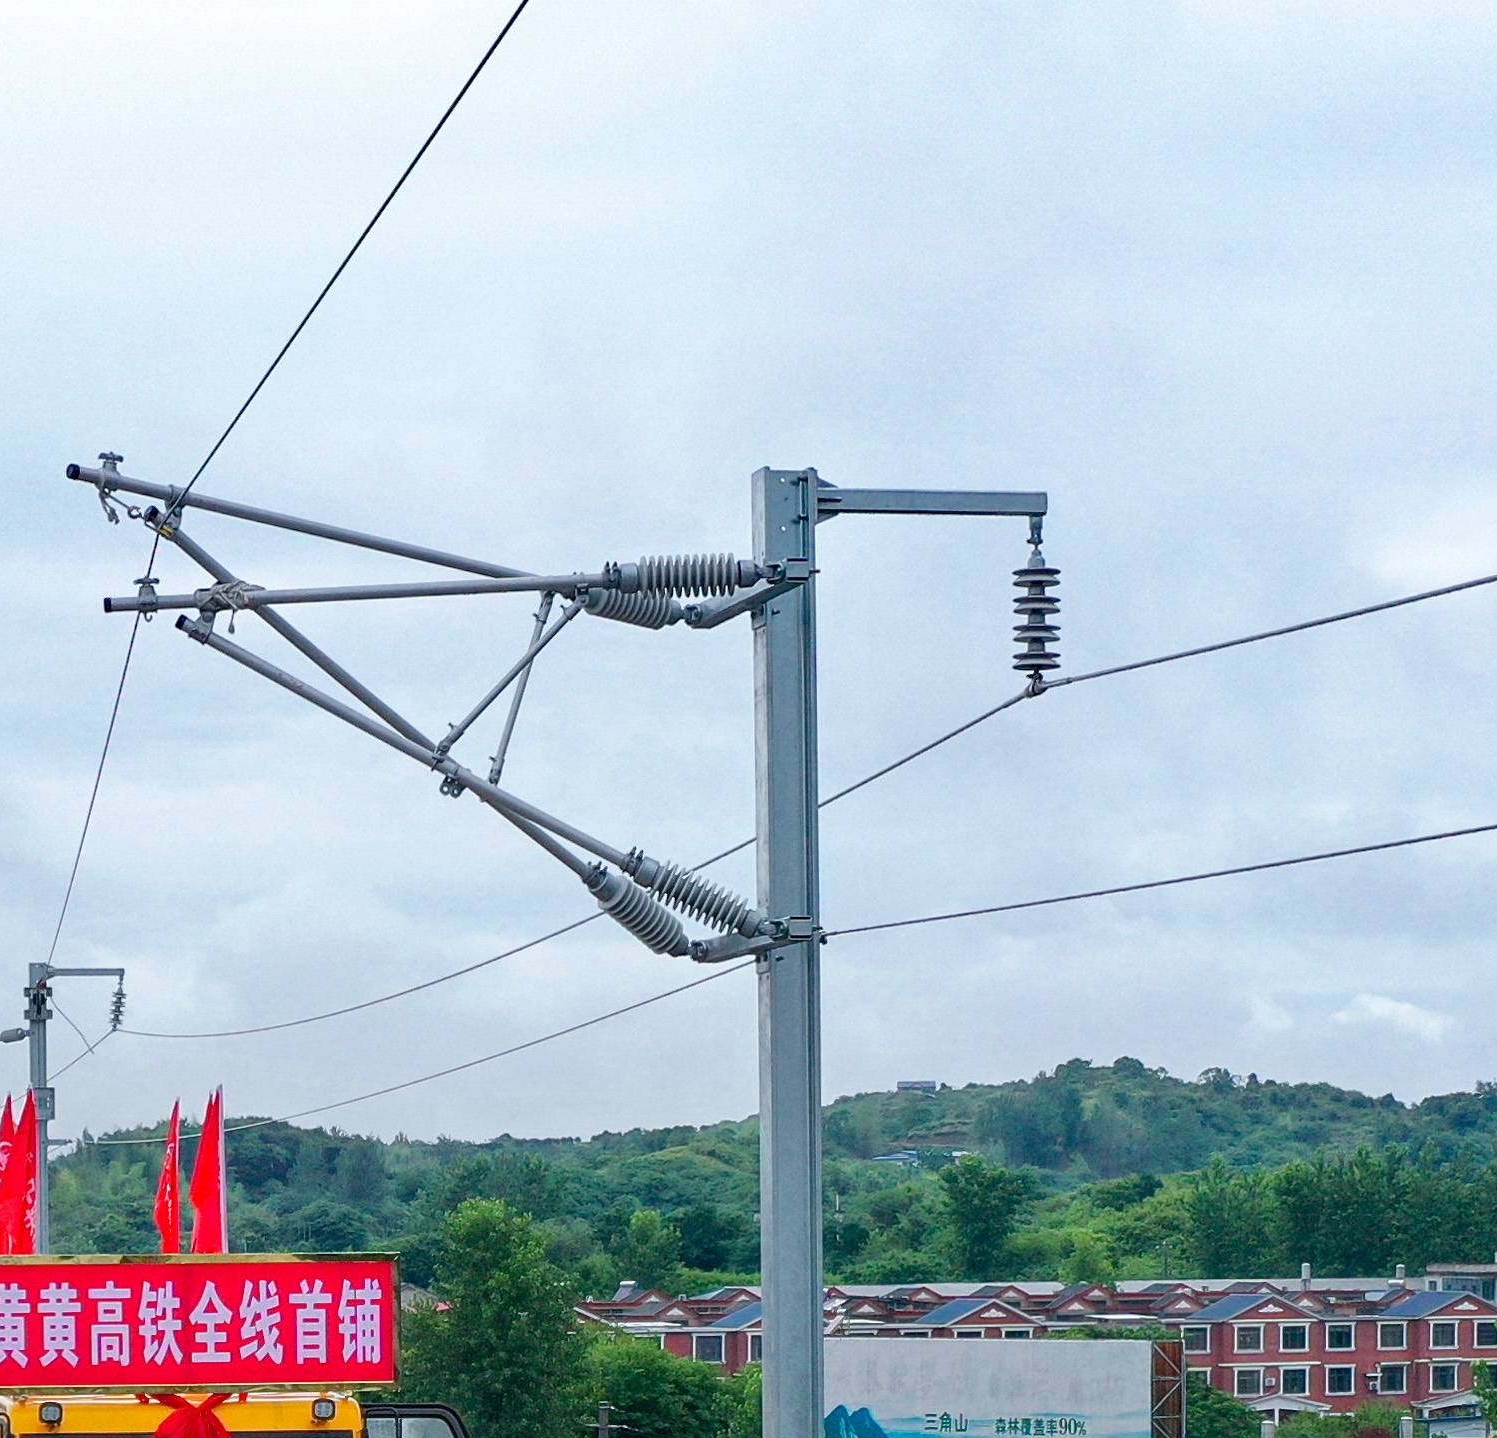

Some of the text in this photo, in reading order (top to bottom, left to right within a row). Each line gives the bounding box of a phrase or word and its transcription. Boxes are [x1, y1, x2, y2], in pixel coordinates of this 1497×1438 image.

[924, 1411, 1087, 1437] 三角山 森林覆盖率90%
